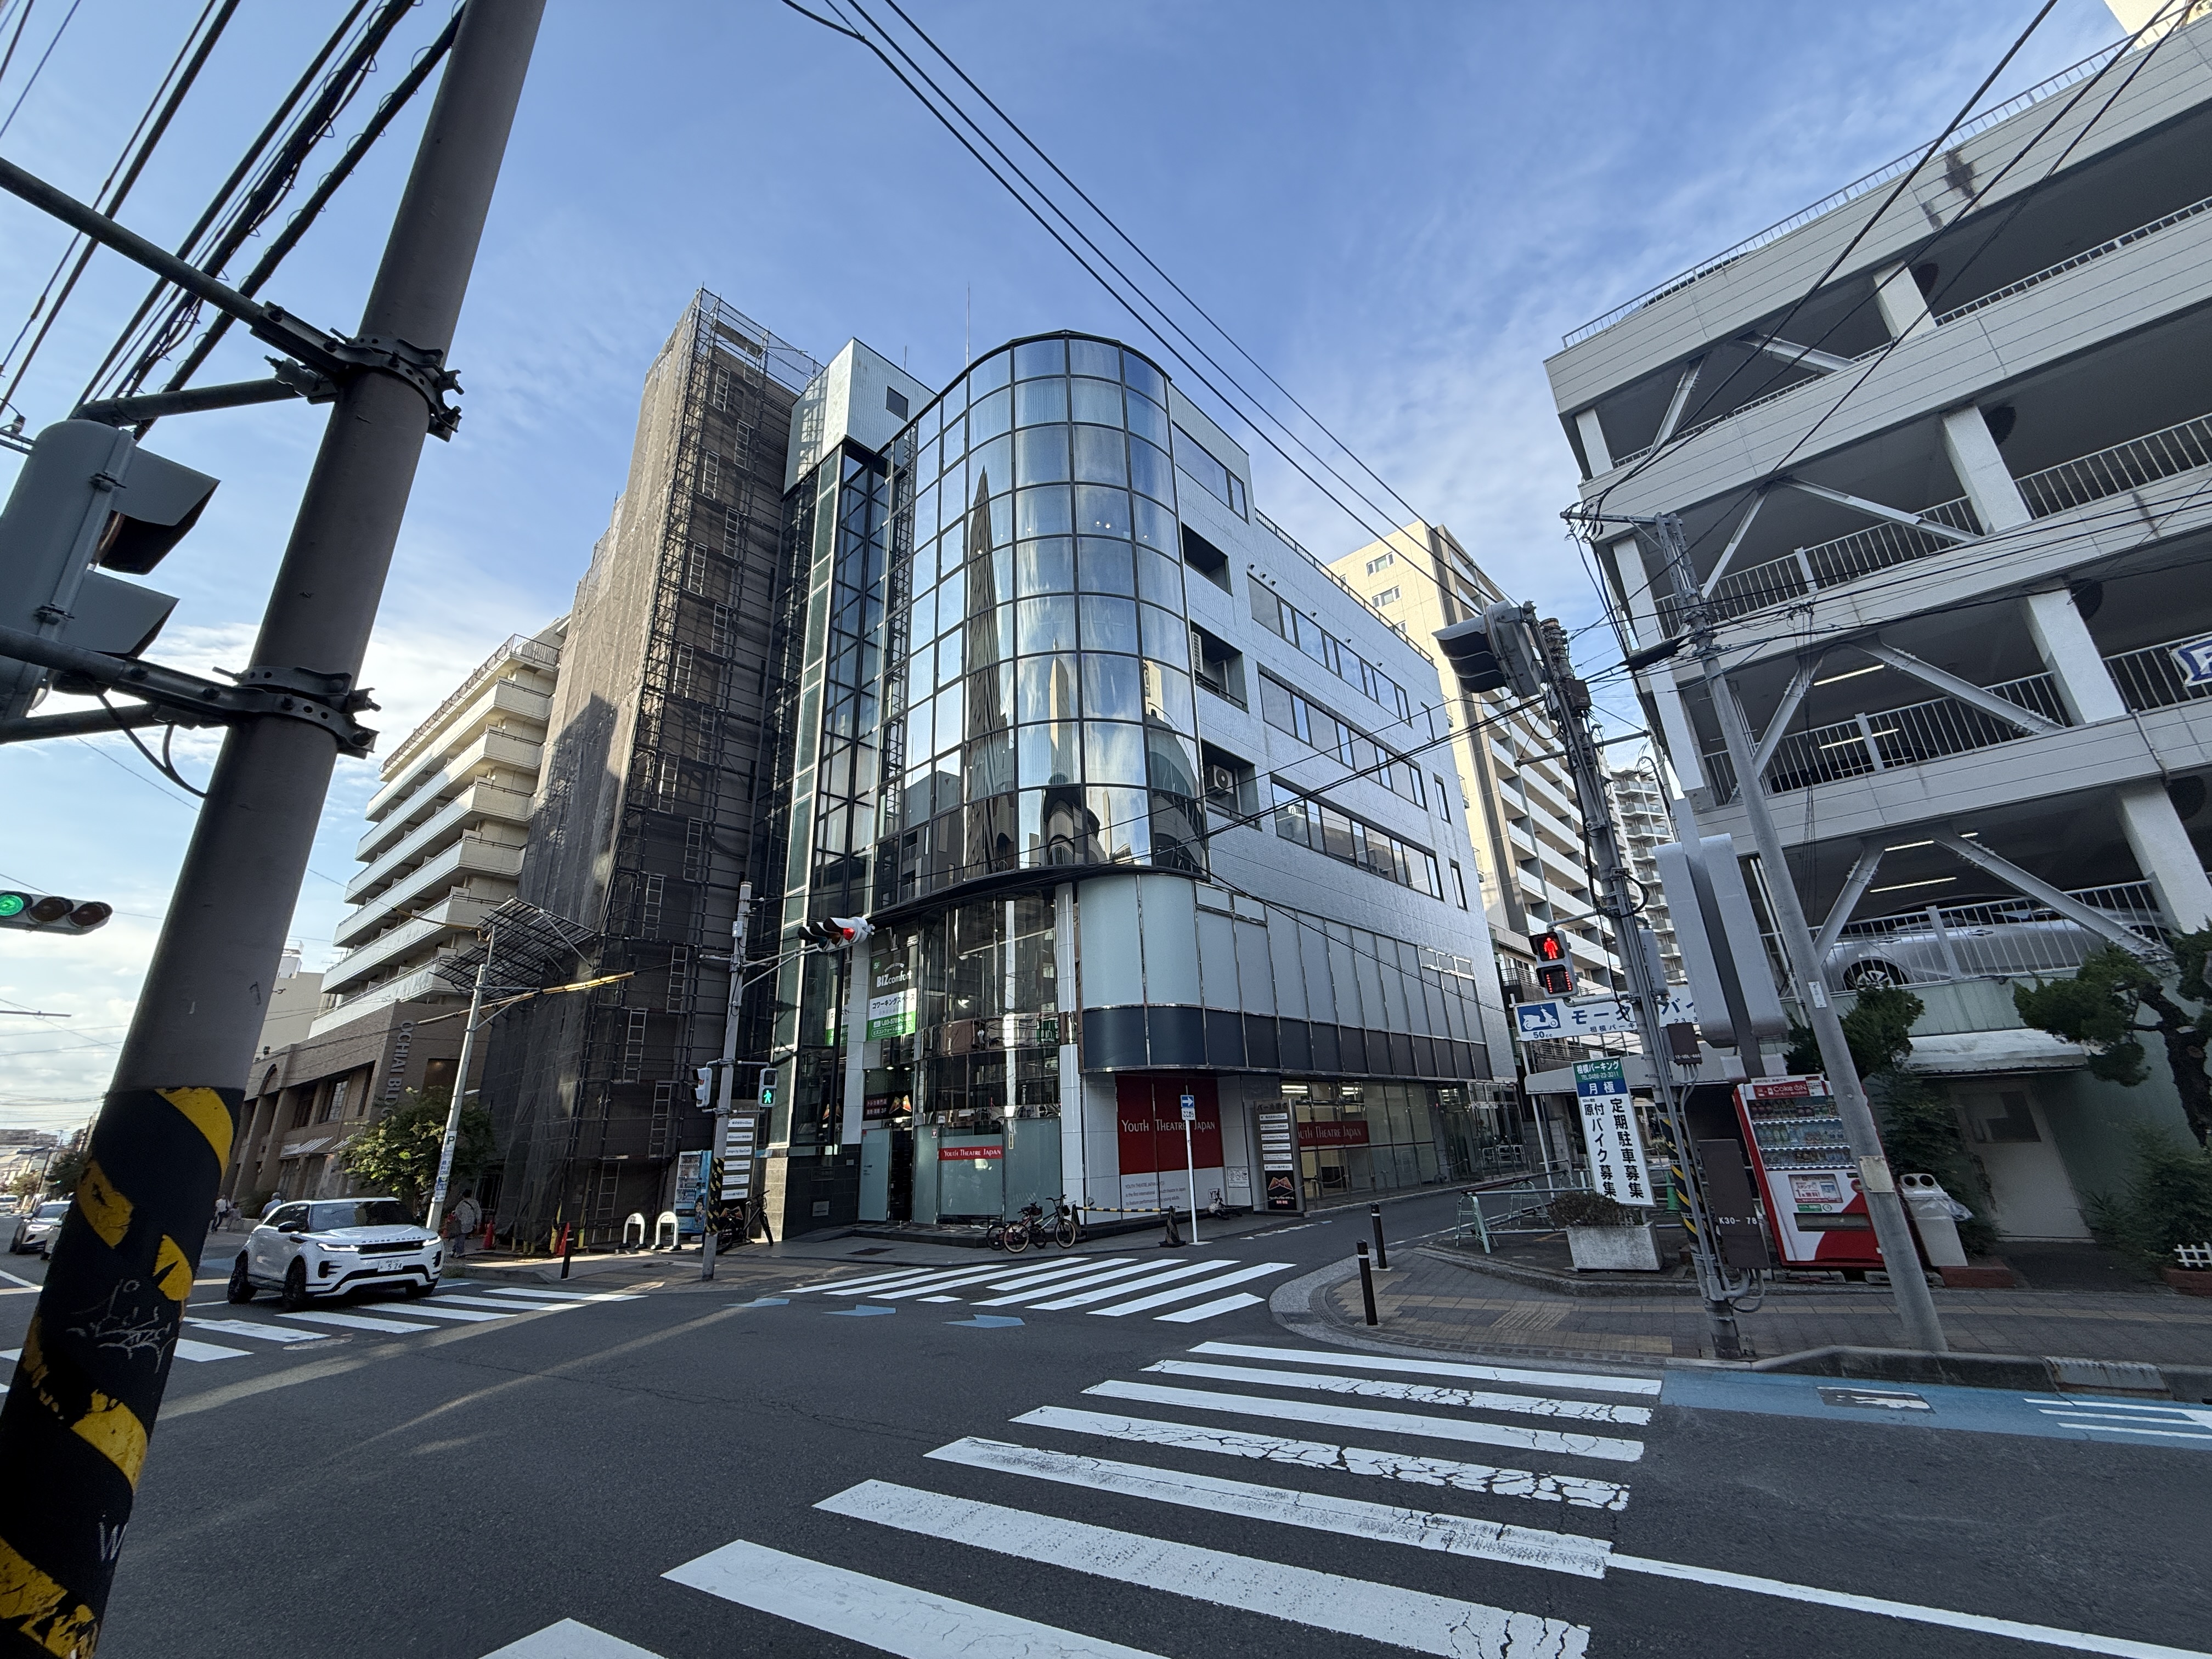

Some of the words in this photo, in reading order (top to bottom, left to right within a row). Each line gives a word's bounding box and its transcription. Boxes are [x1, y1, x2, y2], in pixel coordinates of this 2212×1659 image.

[876, 970, 912, 988] BIZcomfort
[872, 994, 915, 1009] コワーキングスペース
[1533, 1031, 1553, 1039] 50cc
[390, 1019, 414, 1073] OCHIAI
[1577, 1060, 1619, 1074] 相模パーキング
[1589, 1081, 1615, 1094] 月極
[447, 1136, 455, 1145] P
[1584, 1103, 1617, 1198] 原付バイク募集
[1610, 1098, 1644, 1199] 定期駐車募集
[1745, 1217, 1757, 1225] 78
